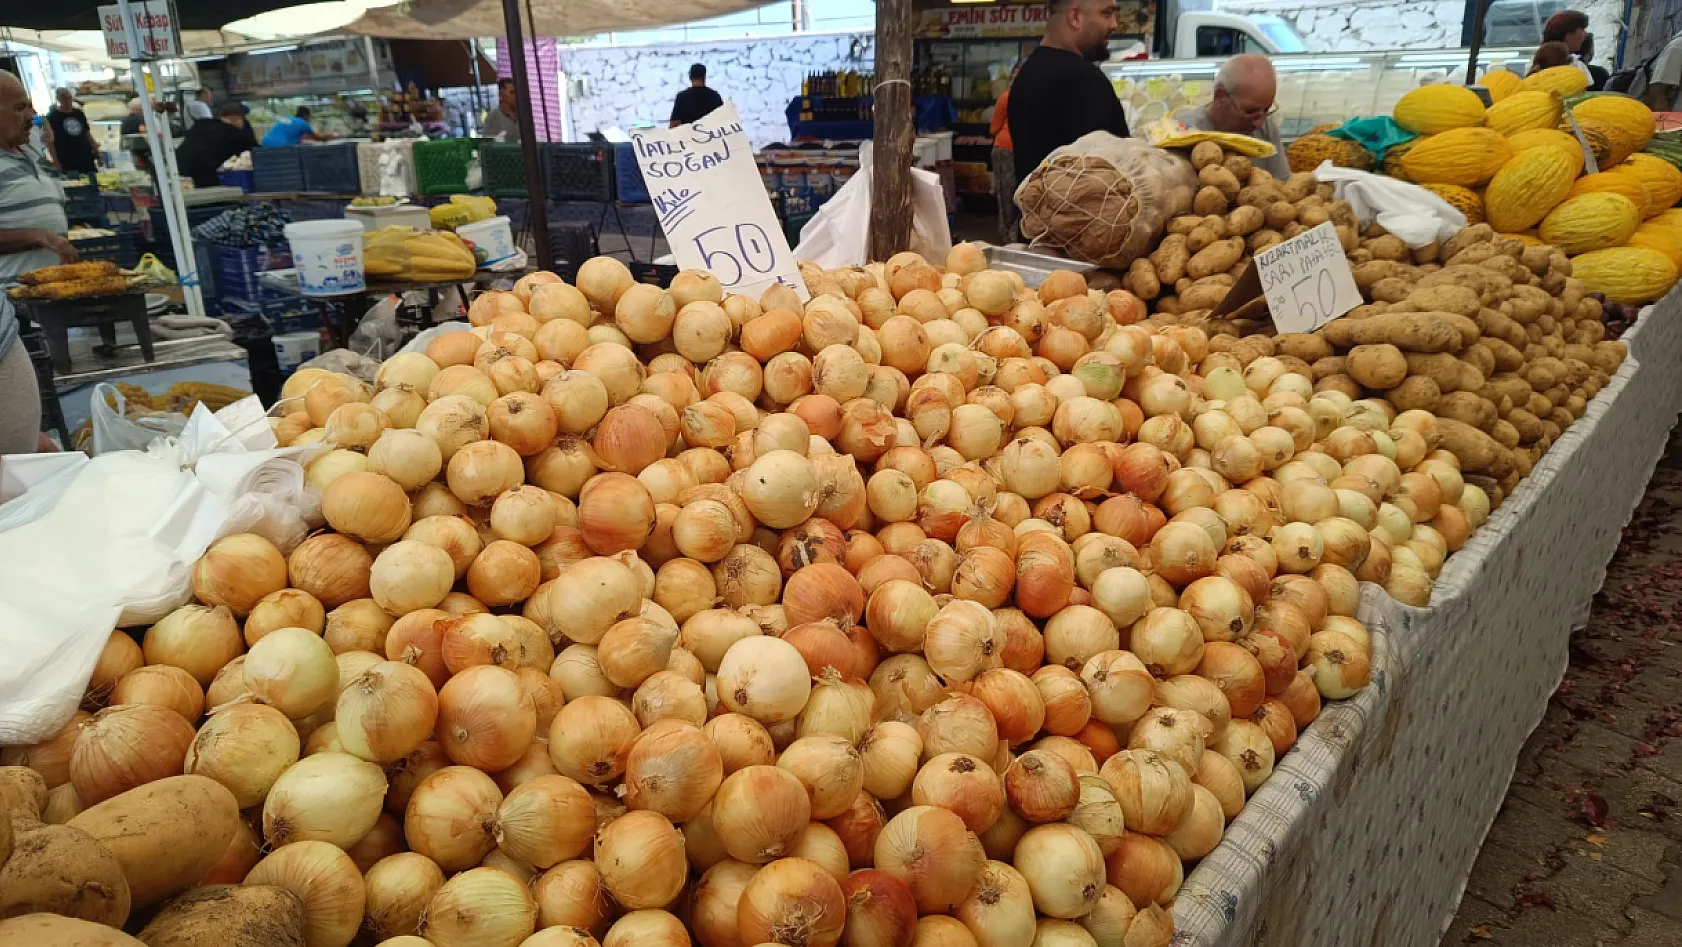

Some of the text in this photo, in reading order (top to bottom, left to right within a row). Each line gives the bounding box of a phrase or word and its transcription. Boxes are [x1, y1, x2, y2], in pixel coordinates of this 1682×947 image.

[989, 4, 1018, 24] SÜT
[647, 141, 730, 178] SOĞAN
[692, 224, 776, 287] 50
[1263, 262, 1295, 293] SARI
[1291, 268, 1337, 333] 50
